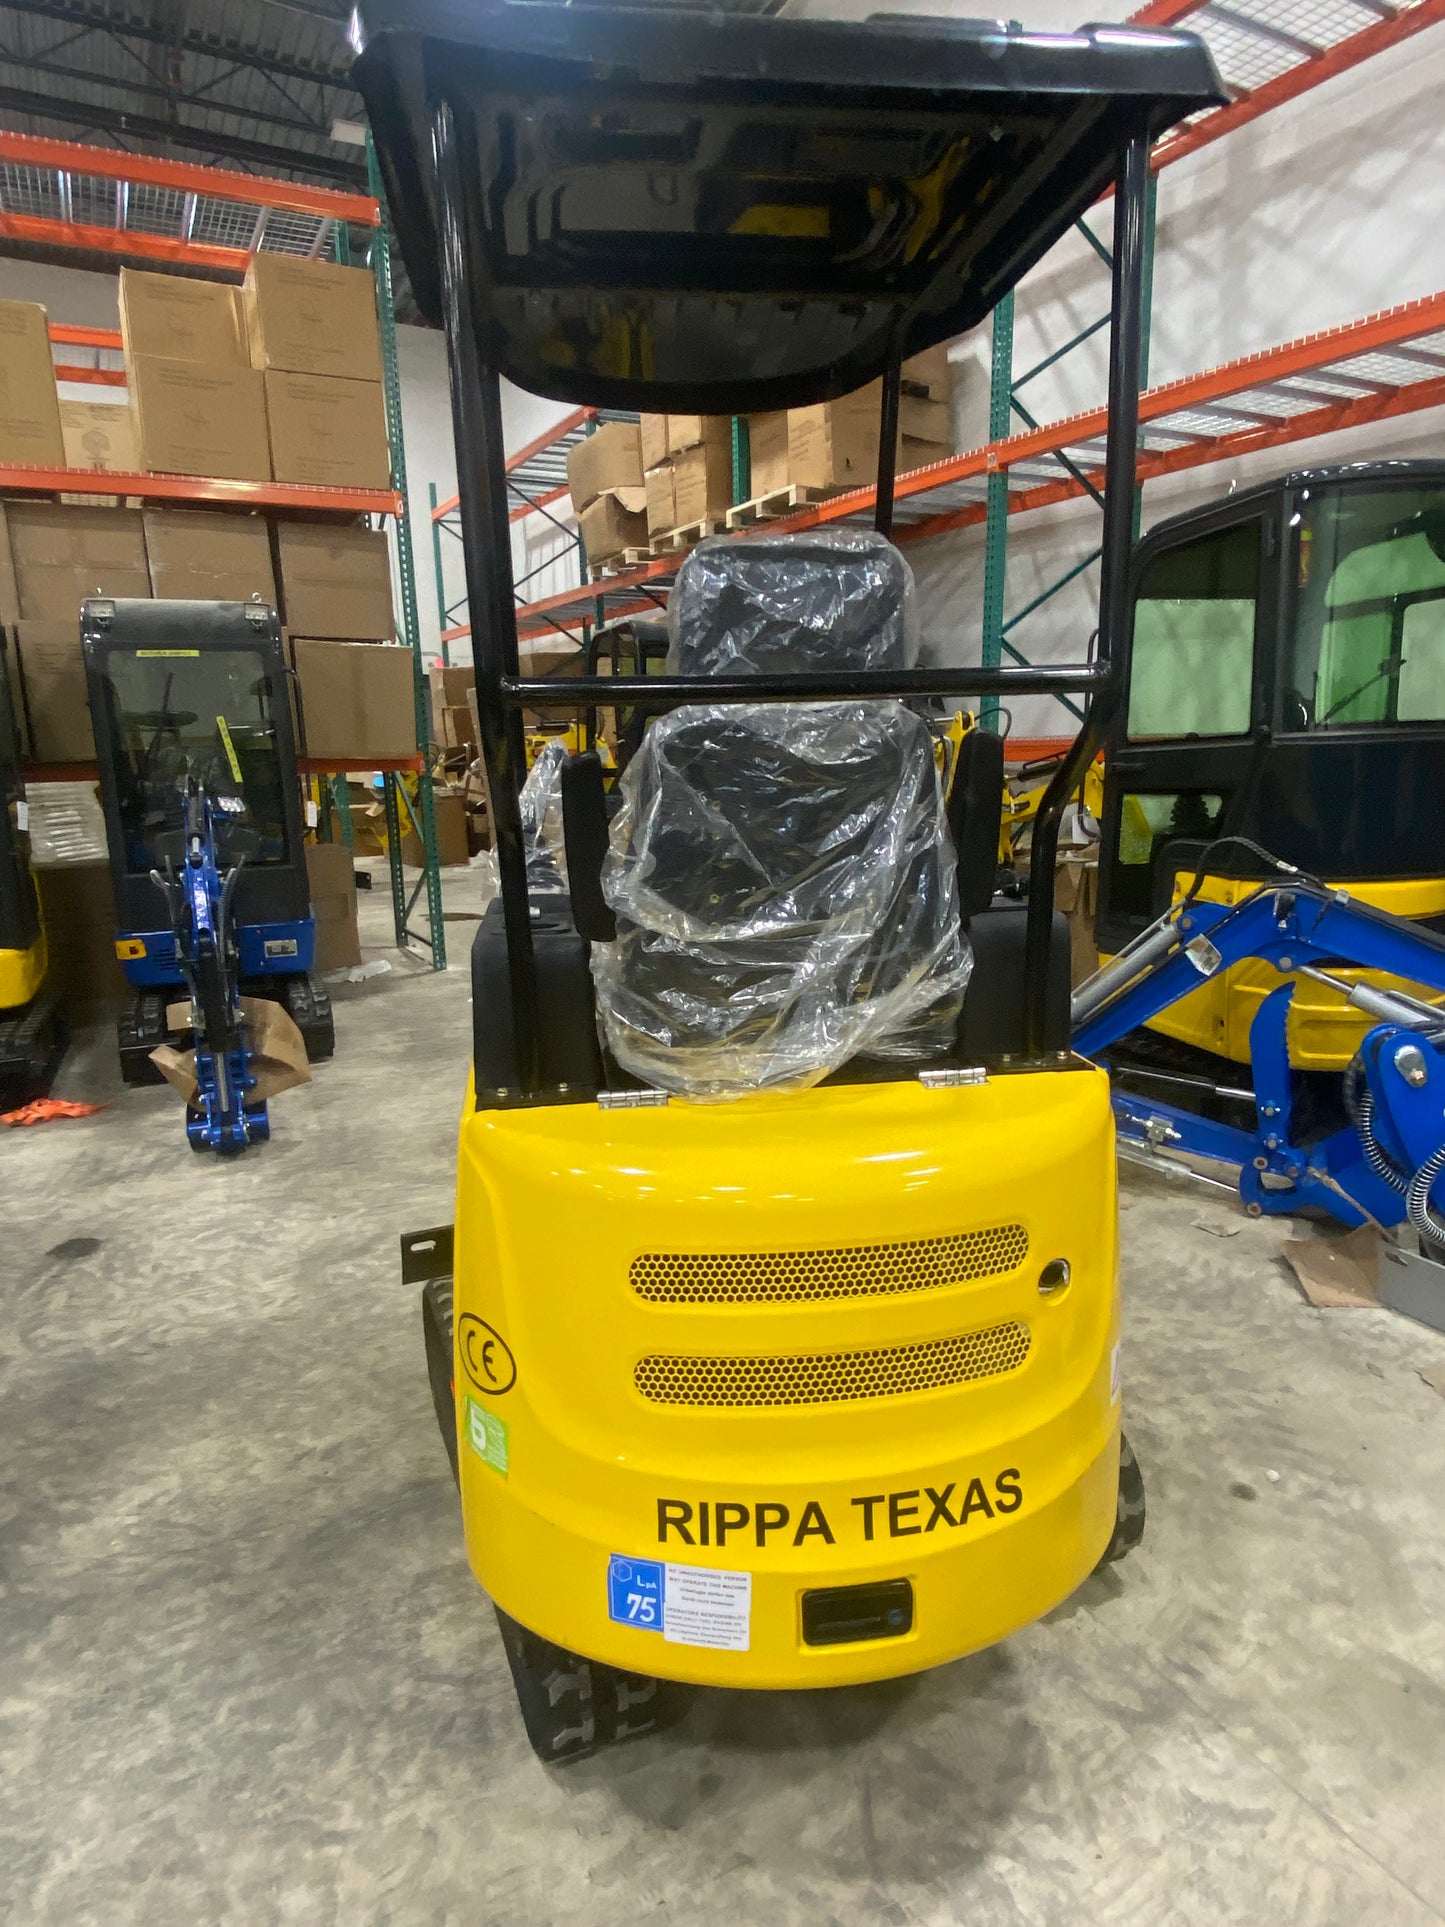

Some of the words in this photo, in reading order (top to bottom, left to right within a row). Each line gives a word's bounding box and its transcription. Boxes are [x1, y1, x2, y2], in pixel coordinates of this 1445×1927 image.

[467, 1330, 497, 1383] CE
[656, 1497, 836, 1548] RIPPA
[850, 1467, 1023, 1542] TEXAS
[682, 1578, 707, 1587] OPERATE
[626, 1592, 657, 1623] 75
